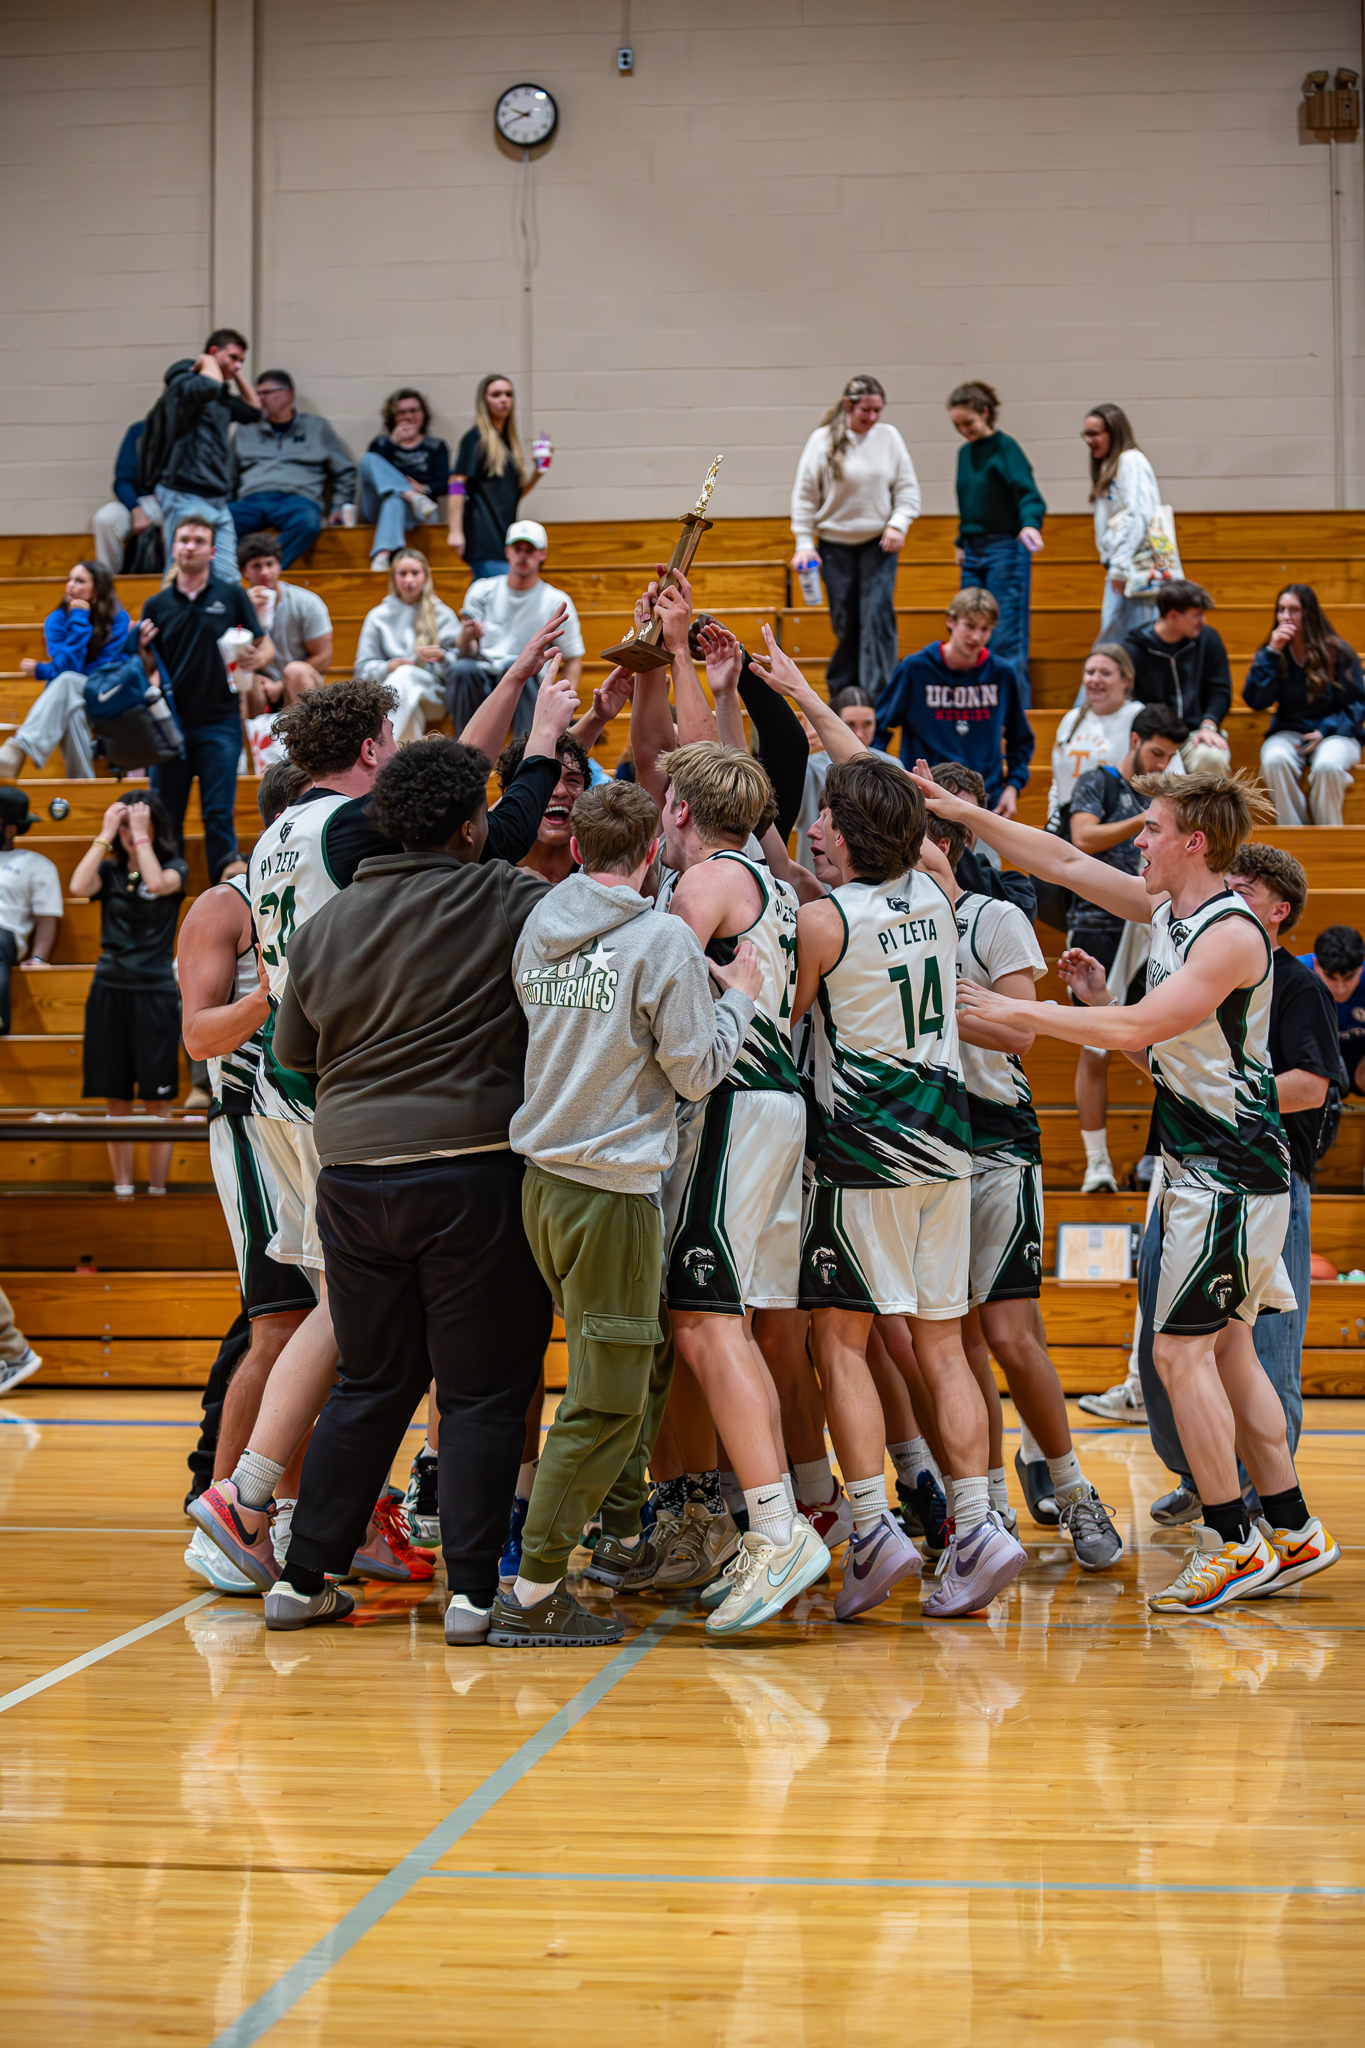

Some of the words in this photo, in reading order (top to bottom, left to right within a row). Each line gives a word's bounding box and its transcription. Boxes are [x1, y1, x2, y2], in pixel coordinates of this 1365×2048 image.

[925, 684, 998, 708] UCONN
[261, 855, 272, 880] PI
[274, 851, 299, 873] ZETA
[877, 928, 898, 955] PI
[898, 918, 938, 946] ZETA
[522, 969, 619, 1014] WOLVERINES
[887, 955, 945, 1051] 14
